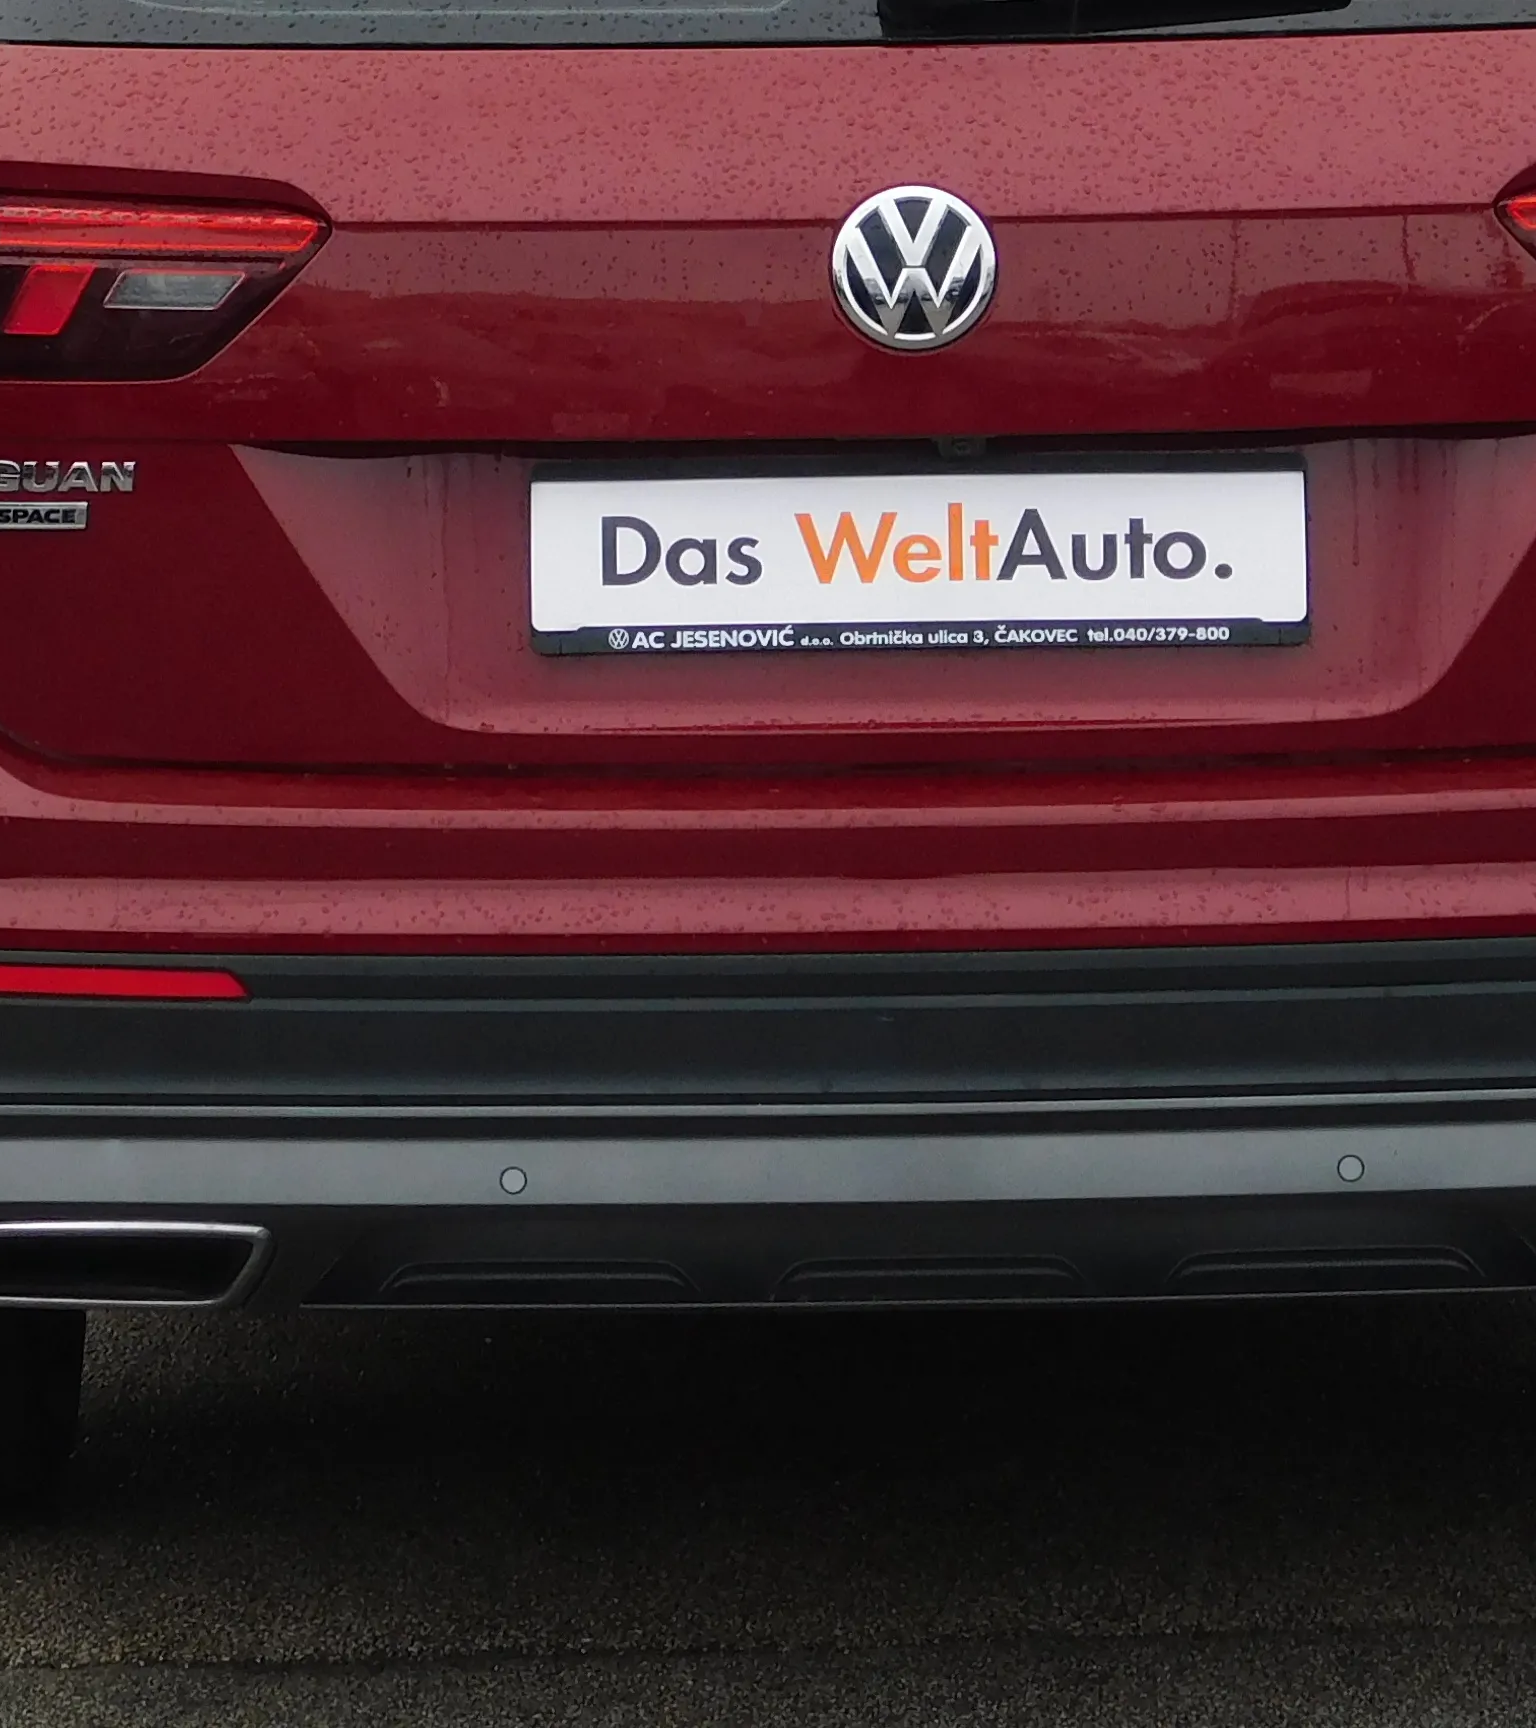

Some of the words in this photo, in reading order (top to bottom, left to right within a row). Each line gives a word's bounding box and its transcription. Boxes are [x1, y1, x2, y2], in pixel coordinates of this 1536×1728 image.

[601, 515, 763, 586] Das
[794, 502, 1233, 584] WeltAuto.
[631, 631, 666, 649] AC
[670, 625, 795, 648] JESENOVIĆ
[928, 630, 968, 645] ulica
[972, 630, 990, 646] 3,
[993, 624, 1079, 645] ČAKOVEC
